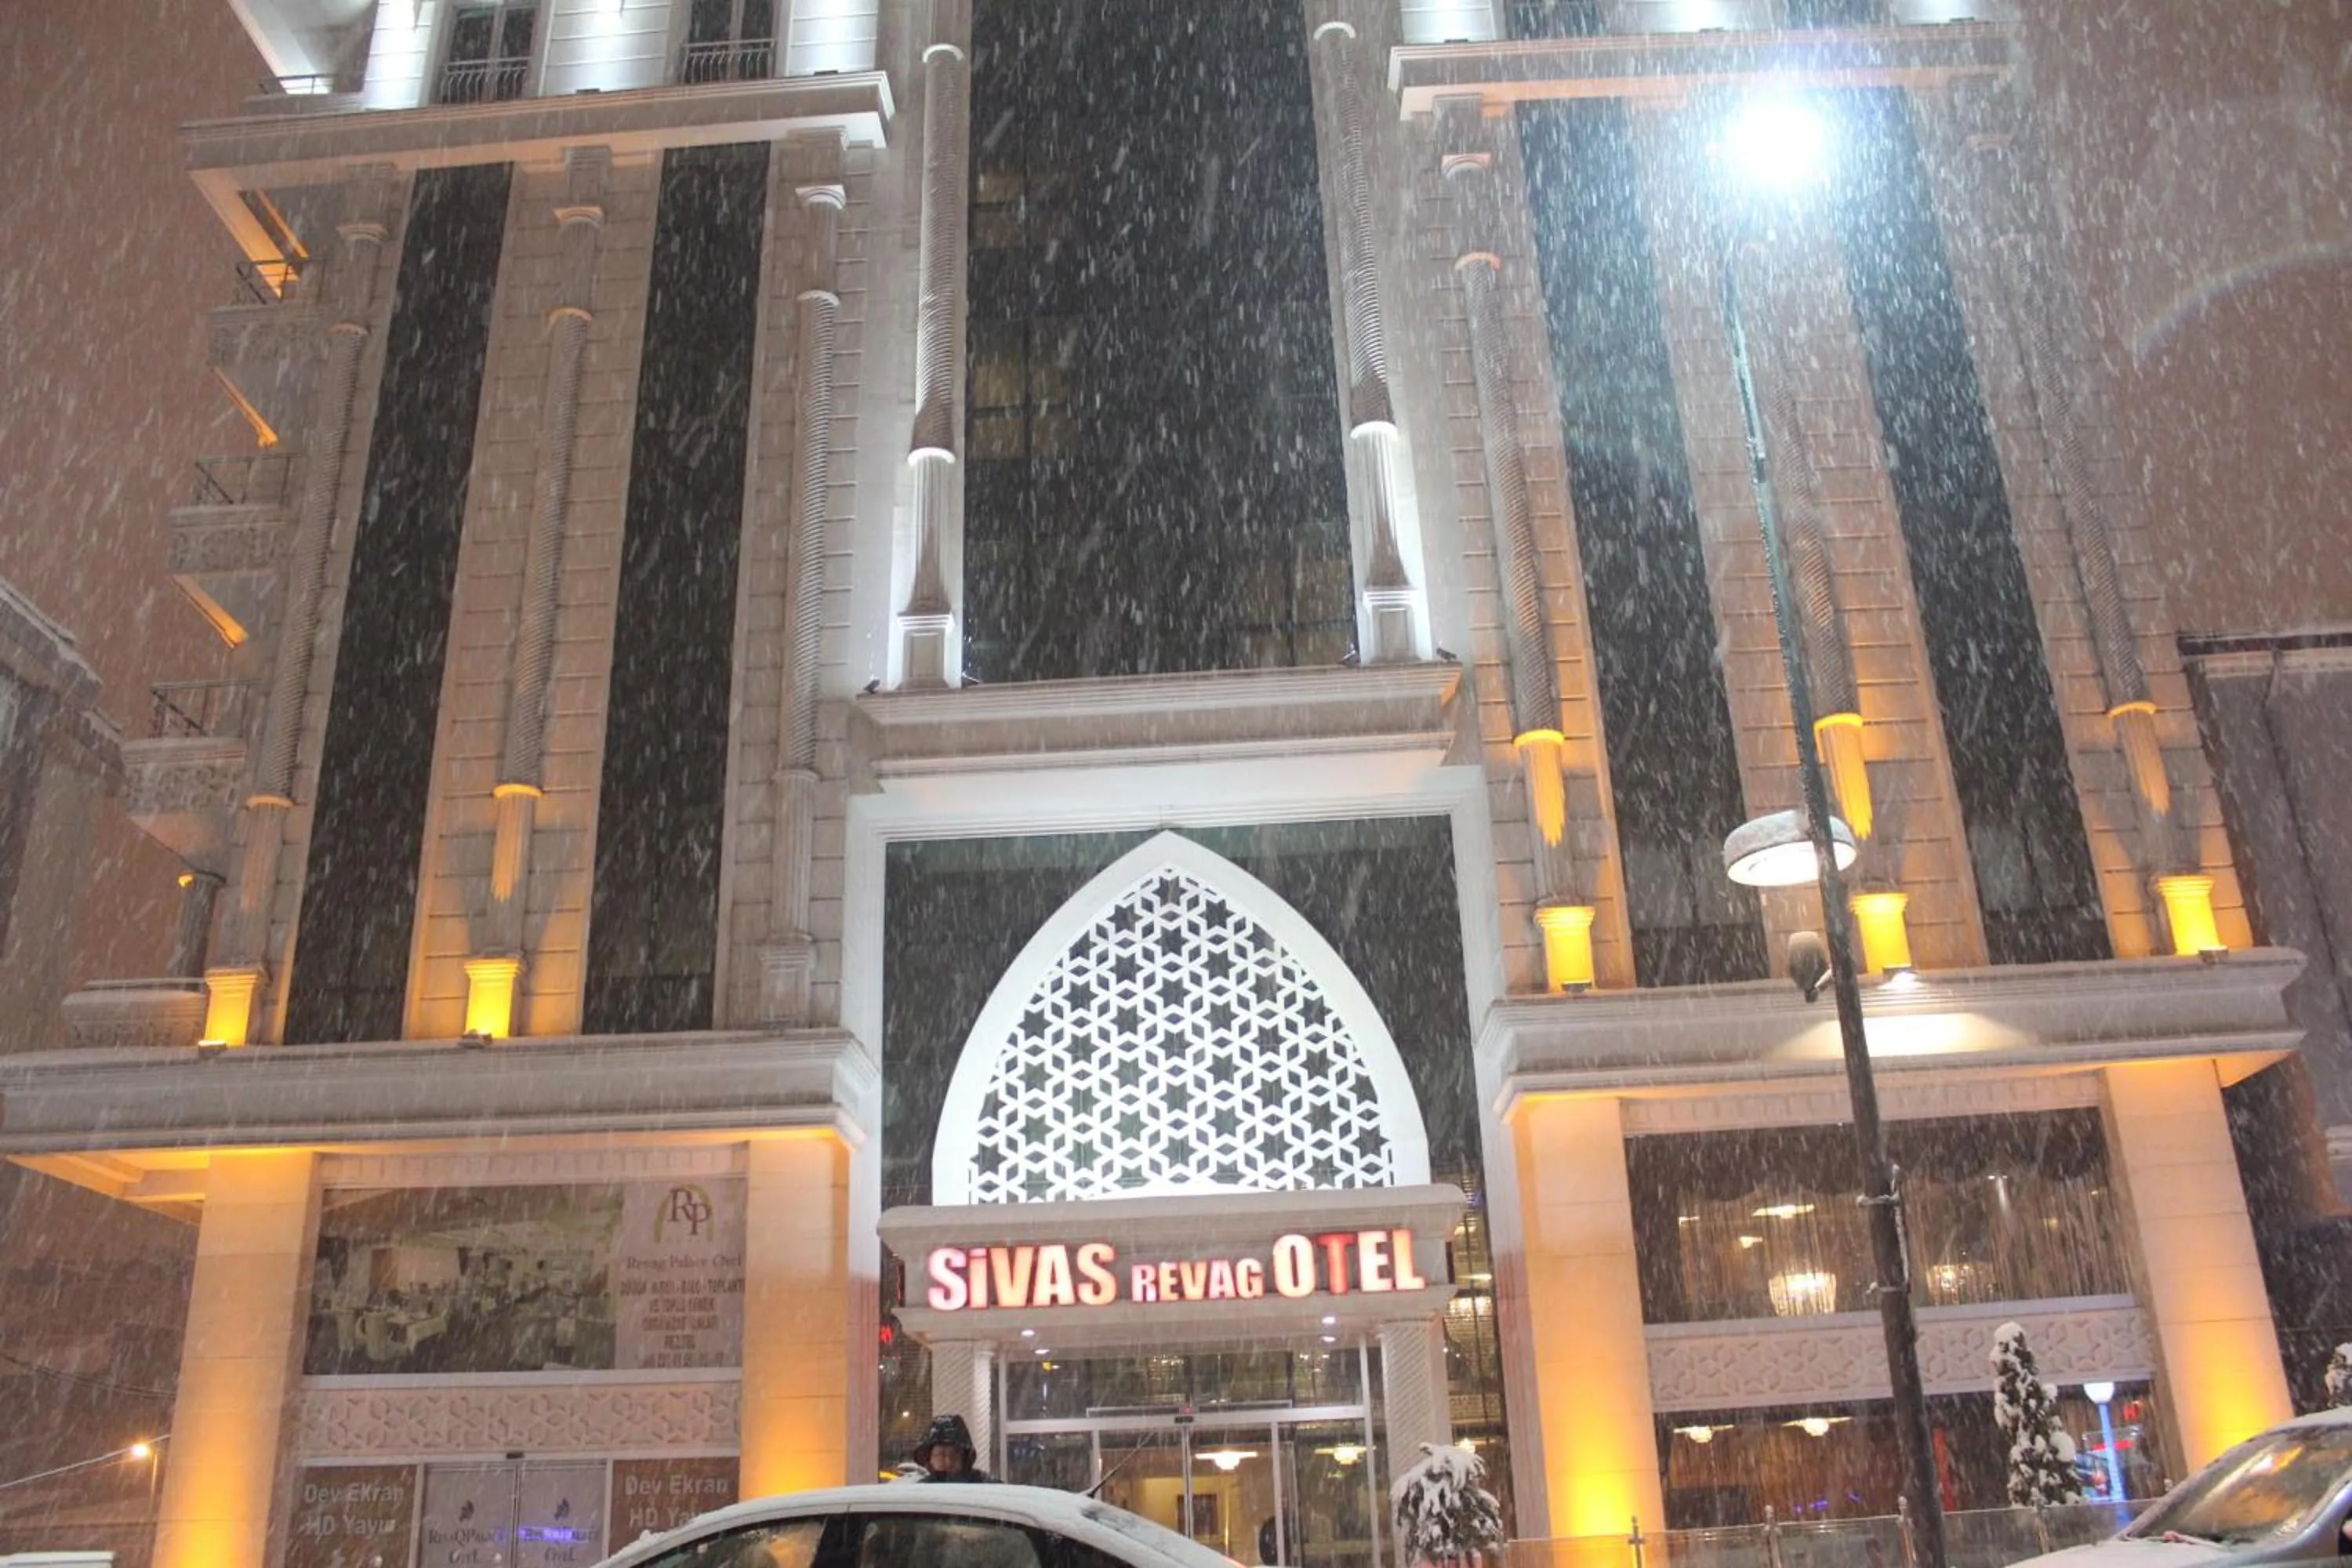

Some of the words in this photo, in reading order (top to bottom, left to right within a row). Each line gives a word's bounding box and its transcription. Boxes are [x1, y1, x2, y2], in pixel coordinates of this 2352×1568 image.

[1131, 1257, 1265, 1302] REVAG
[1272, 1229, 1426, 1298] OTEL
[625, 1475, 662, 1496] Dev
[670, 1474, 728, 1494] Ekran
[629, 1507, 659, 1527] HD
